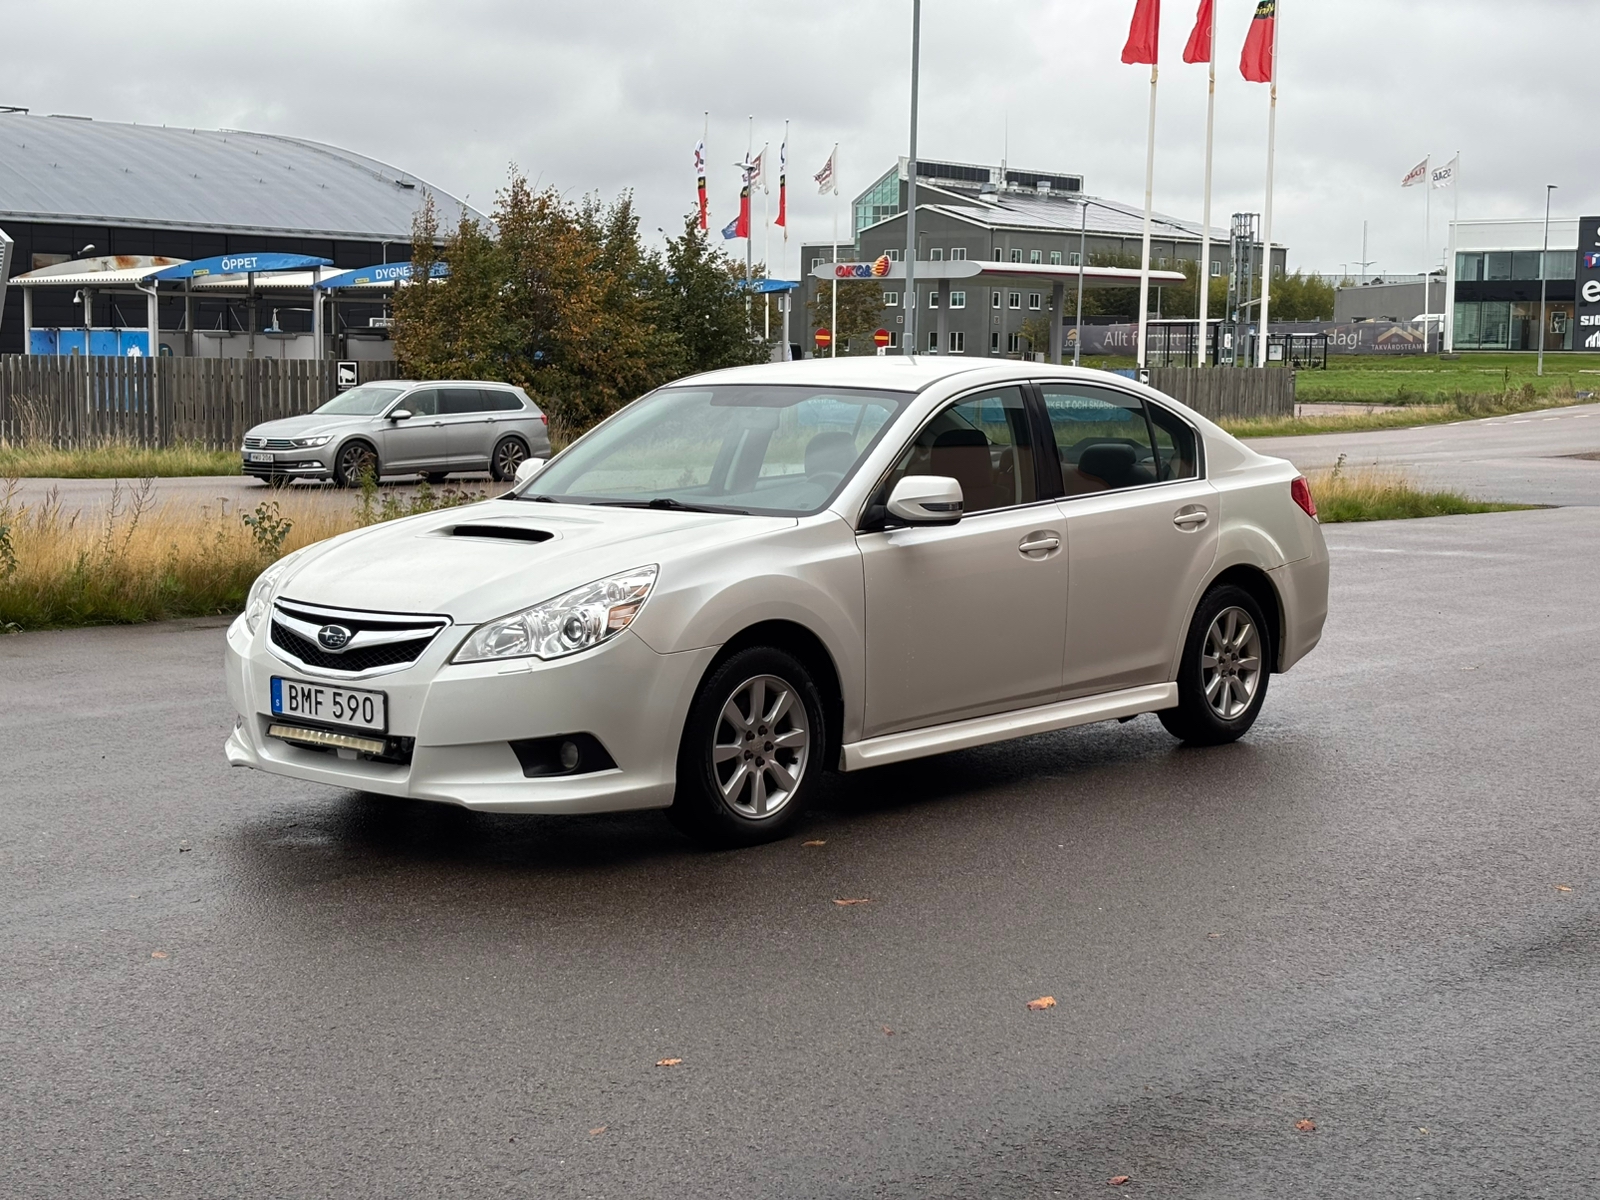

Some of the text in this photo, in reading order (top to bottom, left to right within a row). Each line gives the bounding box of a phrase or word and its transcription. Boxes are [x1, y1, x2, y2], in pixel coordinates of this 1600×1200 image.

[221, 256, 258, 270] ÖPPET
[835, 264, 872, 278] OKQ8
[1104, 331, 1128, 346] Allt
[1071, 400, 1088, 410] OCH
[289, 684, 374, 724] BMF 590
